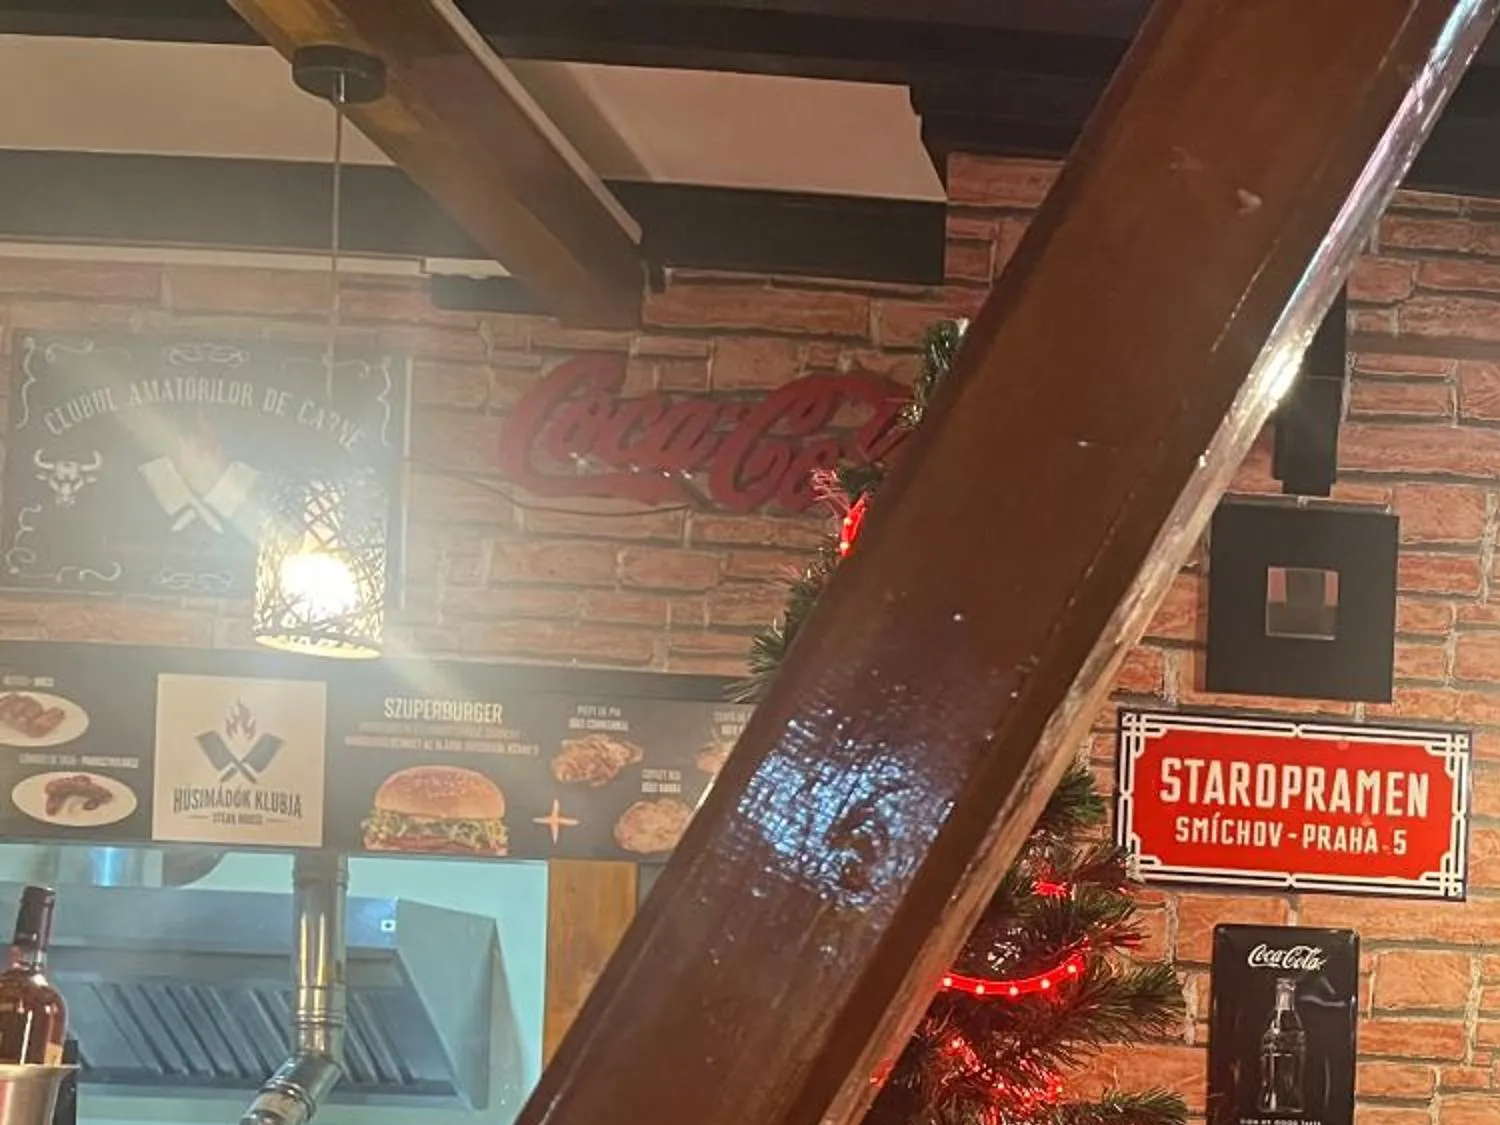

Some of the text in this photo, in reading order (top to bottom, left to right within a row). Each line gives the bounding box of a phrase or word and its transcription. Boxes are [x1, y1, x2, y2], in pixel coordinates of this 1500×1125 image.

[44, 376, 367, 451] CLUBUL AMATORILOR DE CARNE
[505, 352, 915, 515] Coca-Col
[384, 697, 503, 724] SZUPERBURGER
[254, 788, 304, 819] KLUBJA
[1160, 757, 1430, 818] STAROPRAMEN
[1175, 812, 1284, 848] SMÍCHOV
[1302, 827, 1379, 855] PRAHA
[1393, 829, 1408, 855] 5
[1248, 943, 1328, 971] Coca-Cola
